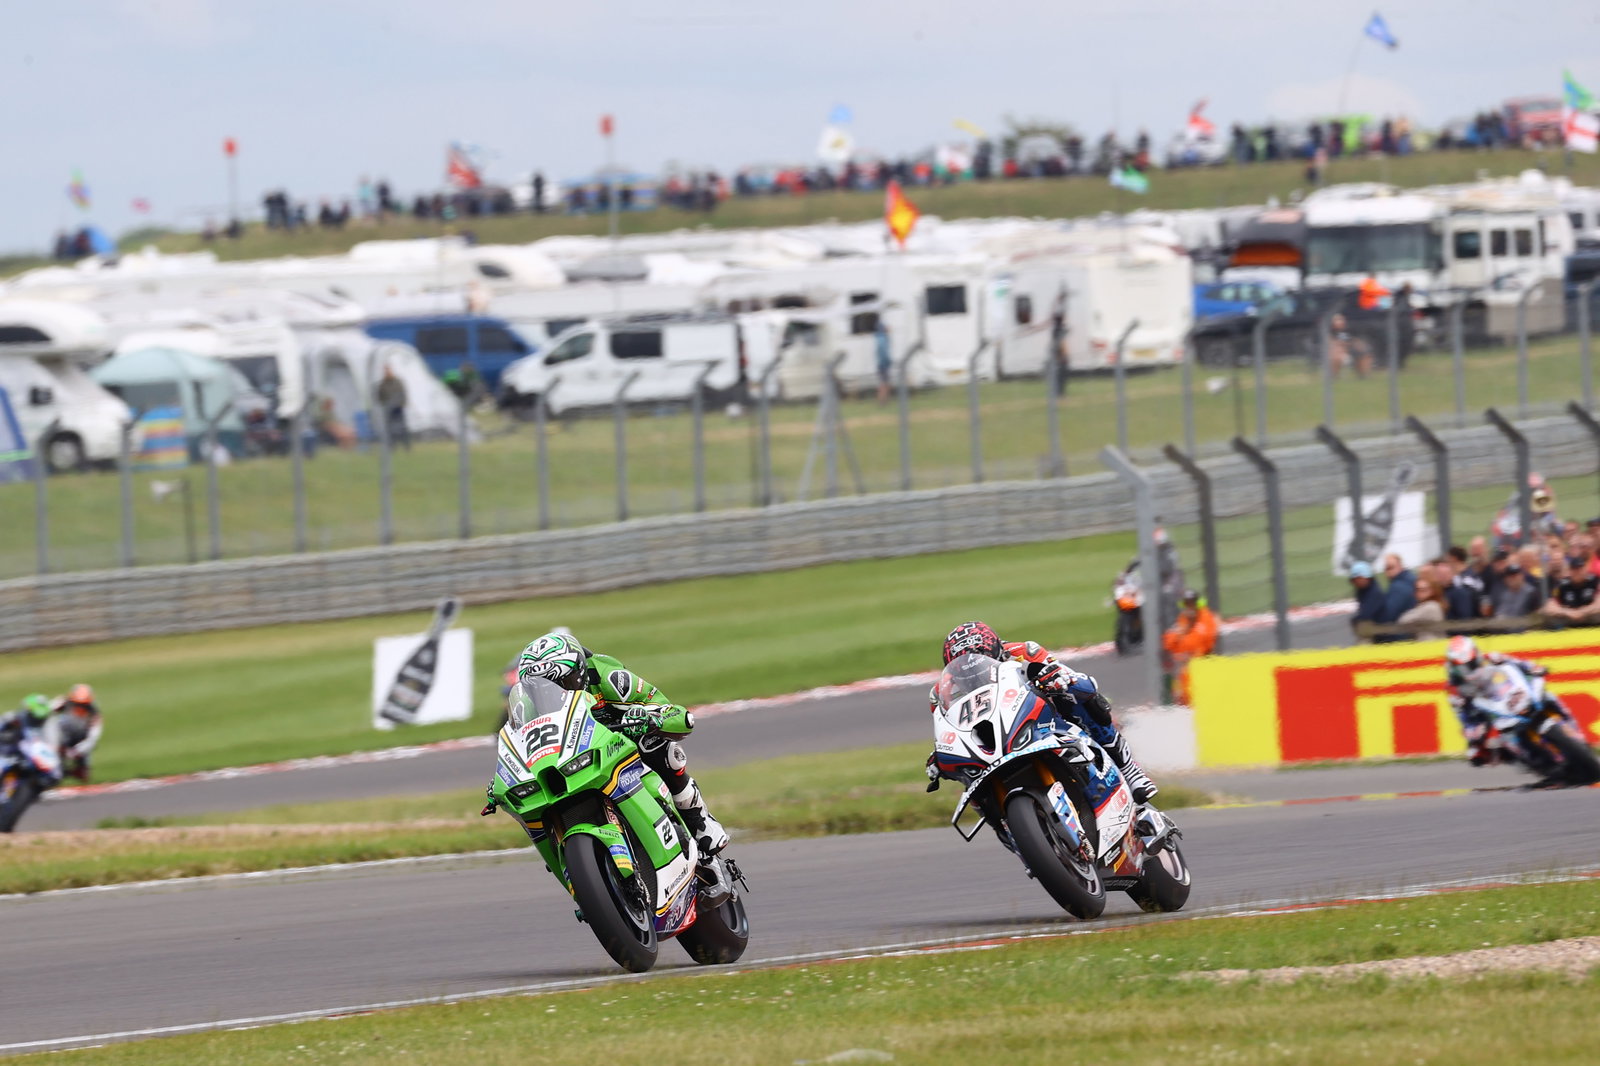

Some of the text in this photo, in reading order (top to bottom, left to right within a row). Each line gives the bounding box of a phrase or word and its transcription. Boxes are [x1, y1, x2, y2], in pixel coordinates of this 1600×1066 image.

[959, 689, 992, 726] 45
[521, 716, 552, 735] SHOWA
[566, 717, 582, 749] Kawasaki
[525, 723, 560, 760] 22
[606, 735, 626, 758] Ninja
[503, 752, 522, 775] Kawasaki
[530, 747, 556, 764] MOTUL
[661, 821, 673, 846] 22
[663, 863, 690, 899] Kawasaki
